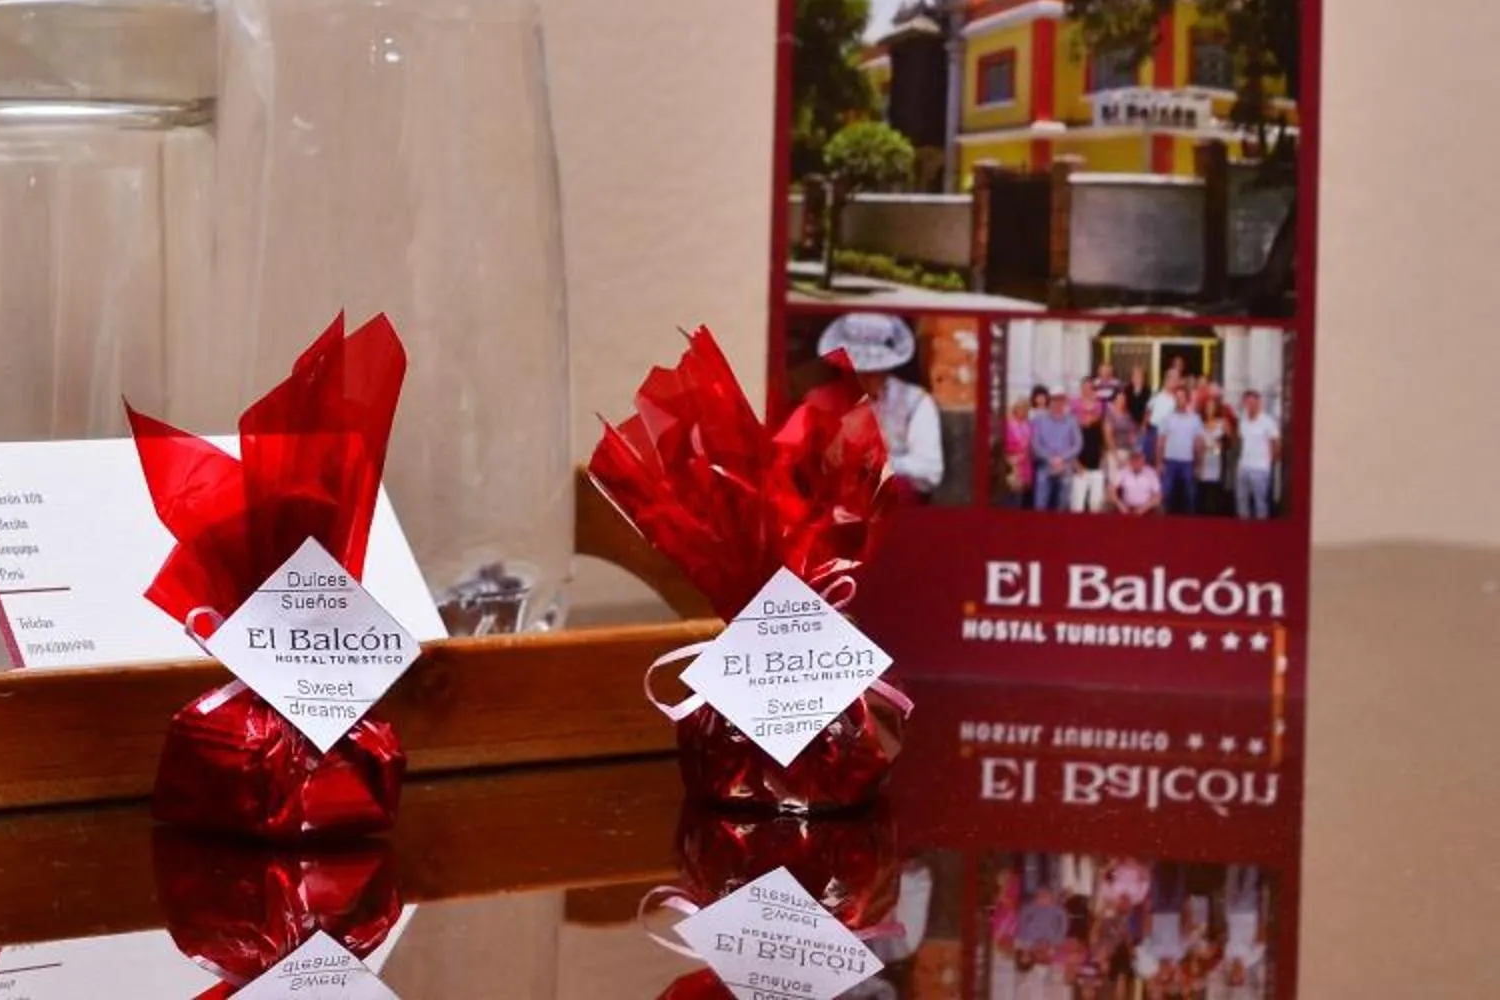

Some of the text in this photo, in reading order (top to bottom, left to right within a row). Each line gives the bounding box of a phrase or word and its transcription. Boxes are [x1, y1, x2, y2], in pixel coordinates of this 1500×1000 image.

[287, 571, 348, 589] Dulces
[985, 561, 1286, 617] El Balcón
[281, 592, 348, 611] Sueños
[763, 599, 821, 615] Dulces
[757, 619, 823, 636] Sueños
[962, 619, 1173, 648] HOSTAL TURISTICO
[248, 625, 402, 652] El Balcón
[275, 654, 404, 666] HOSTAL TURISTICO
[723, 645, 875, 678] El Balcón
[297, 679, 355, 698] Sweet
[749, 676, 799, 686] HOSTAL
[289, 700, 357, 720] dreams
[767, 696, 824, 715] Sweet
[754, 718, 823, 737] dreams
